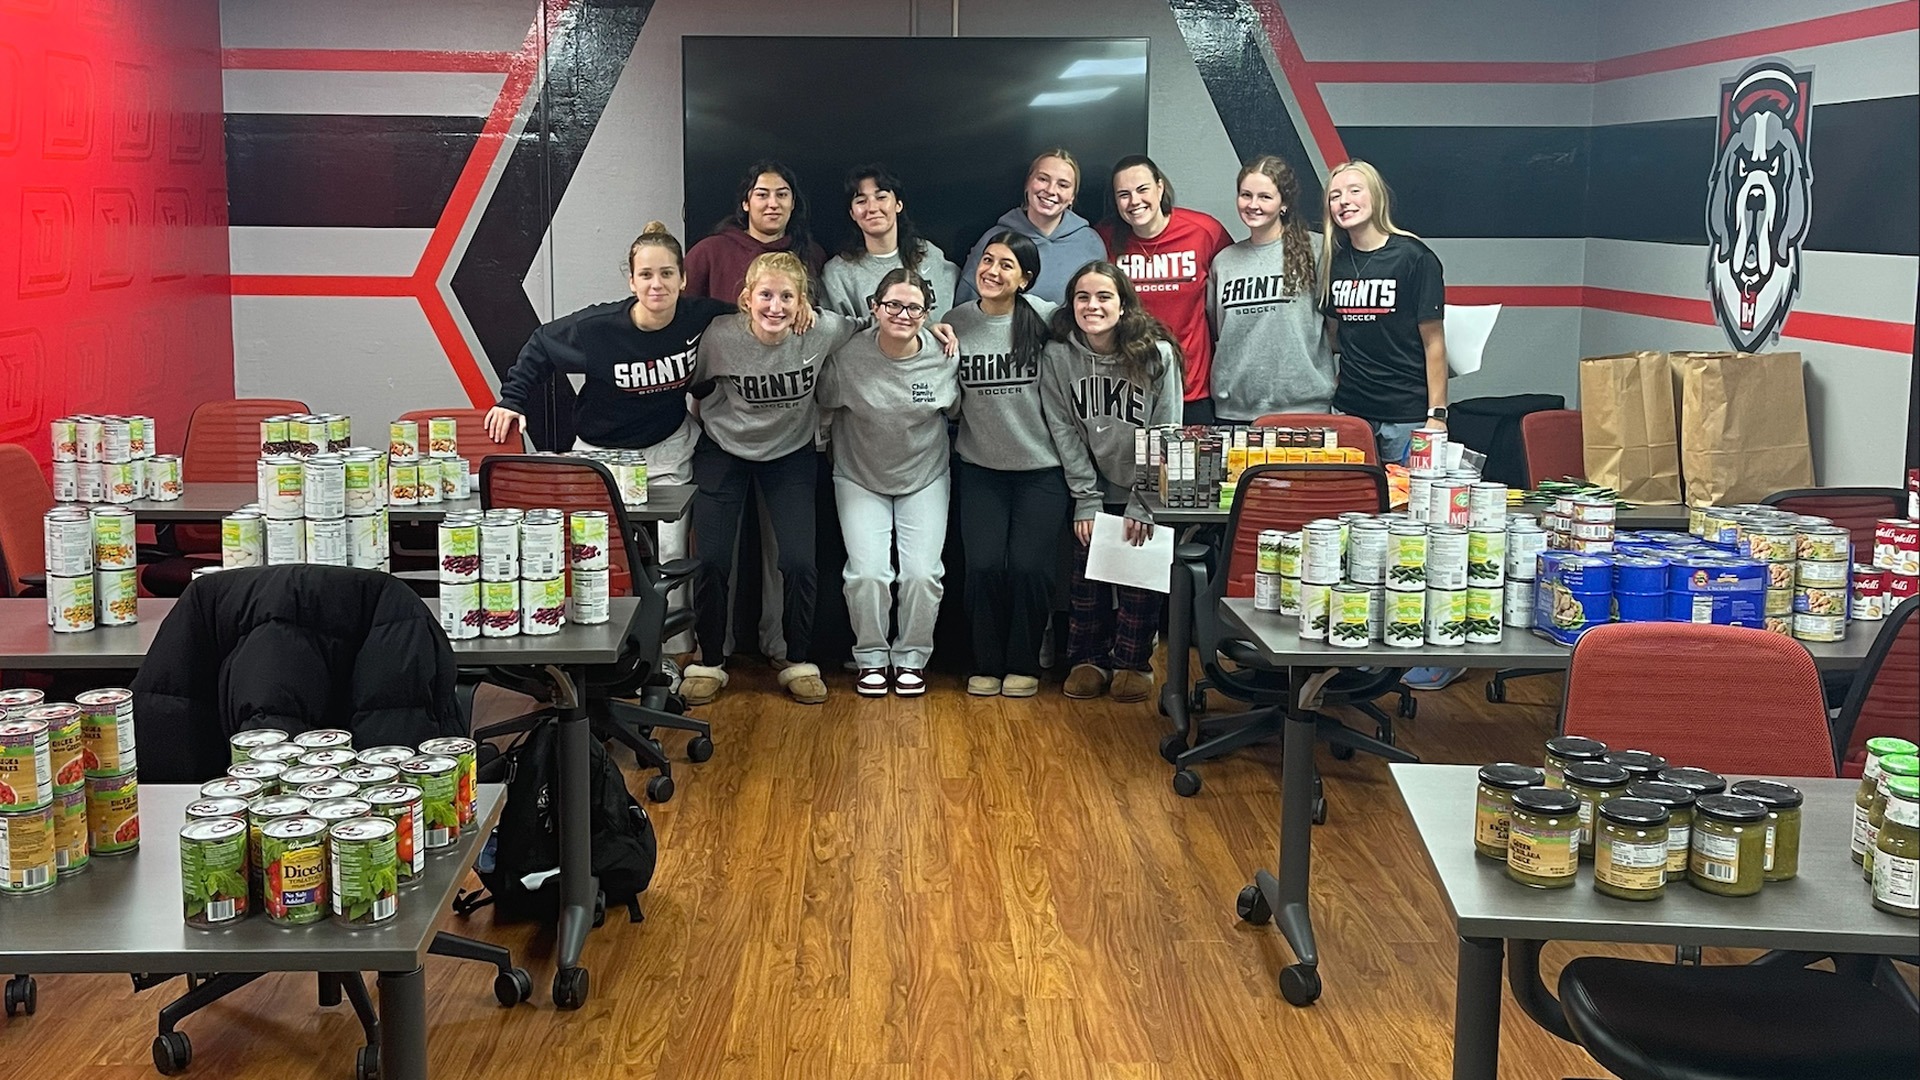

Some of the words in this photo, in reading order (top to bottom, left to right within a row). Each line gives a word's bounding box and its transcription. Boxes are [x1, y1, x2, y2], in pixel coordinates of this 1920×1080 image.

[1116, 250, 1197, 279] SAINTS
[1134, 284, 1180, 292] SOCCER
[1222, 274, 1285, 303] SAINT
[1331, 279, 1396, 307] SAINTS
[1235, 306, 1276, 315] SOCCER
[1342, 314, 1377, 322] SOCCER
[613, 347, 698, 389] SAINTS
[960, 352, 1038, 382] SAINTS
[729, 365, 814, 400] SAINTS
[912, 382, 928, 390] Child
[977, 387, 1023, 396] SOCCER
[752, 400, 801, 410] SOCCER
[1069, 375, 1146, 427] NIKE
[284, 860, 324, 879] Diced
